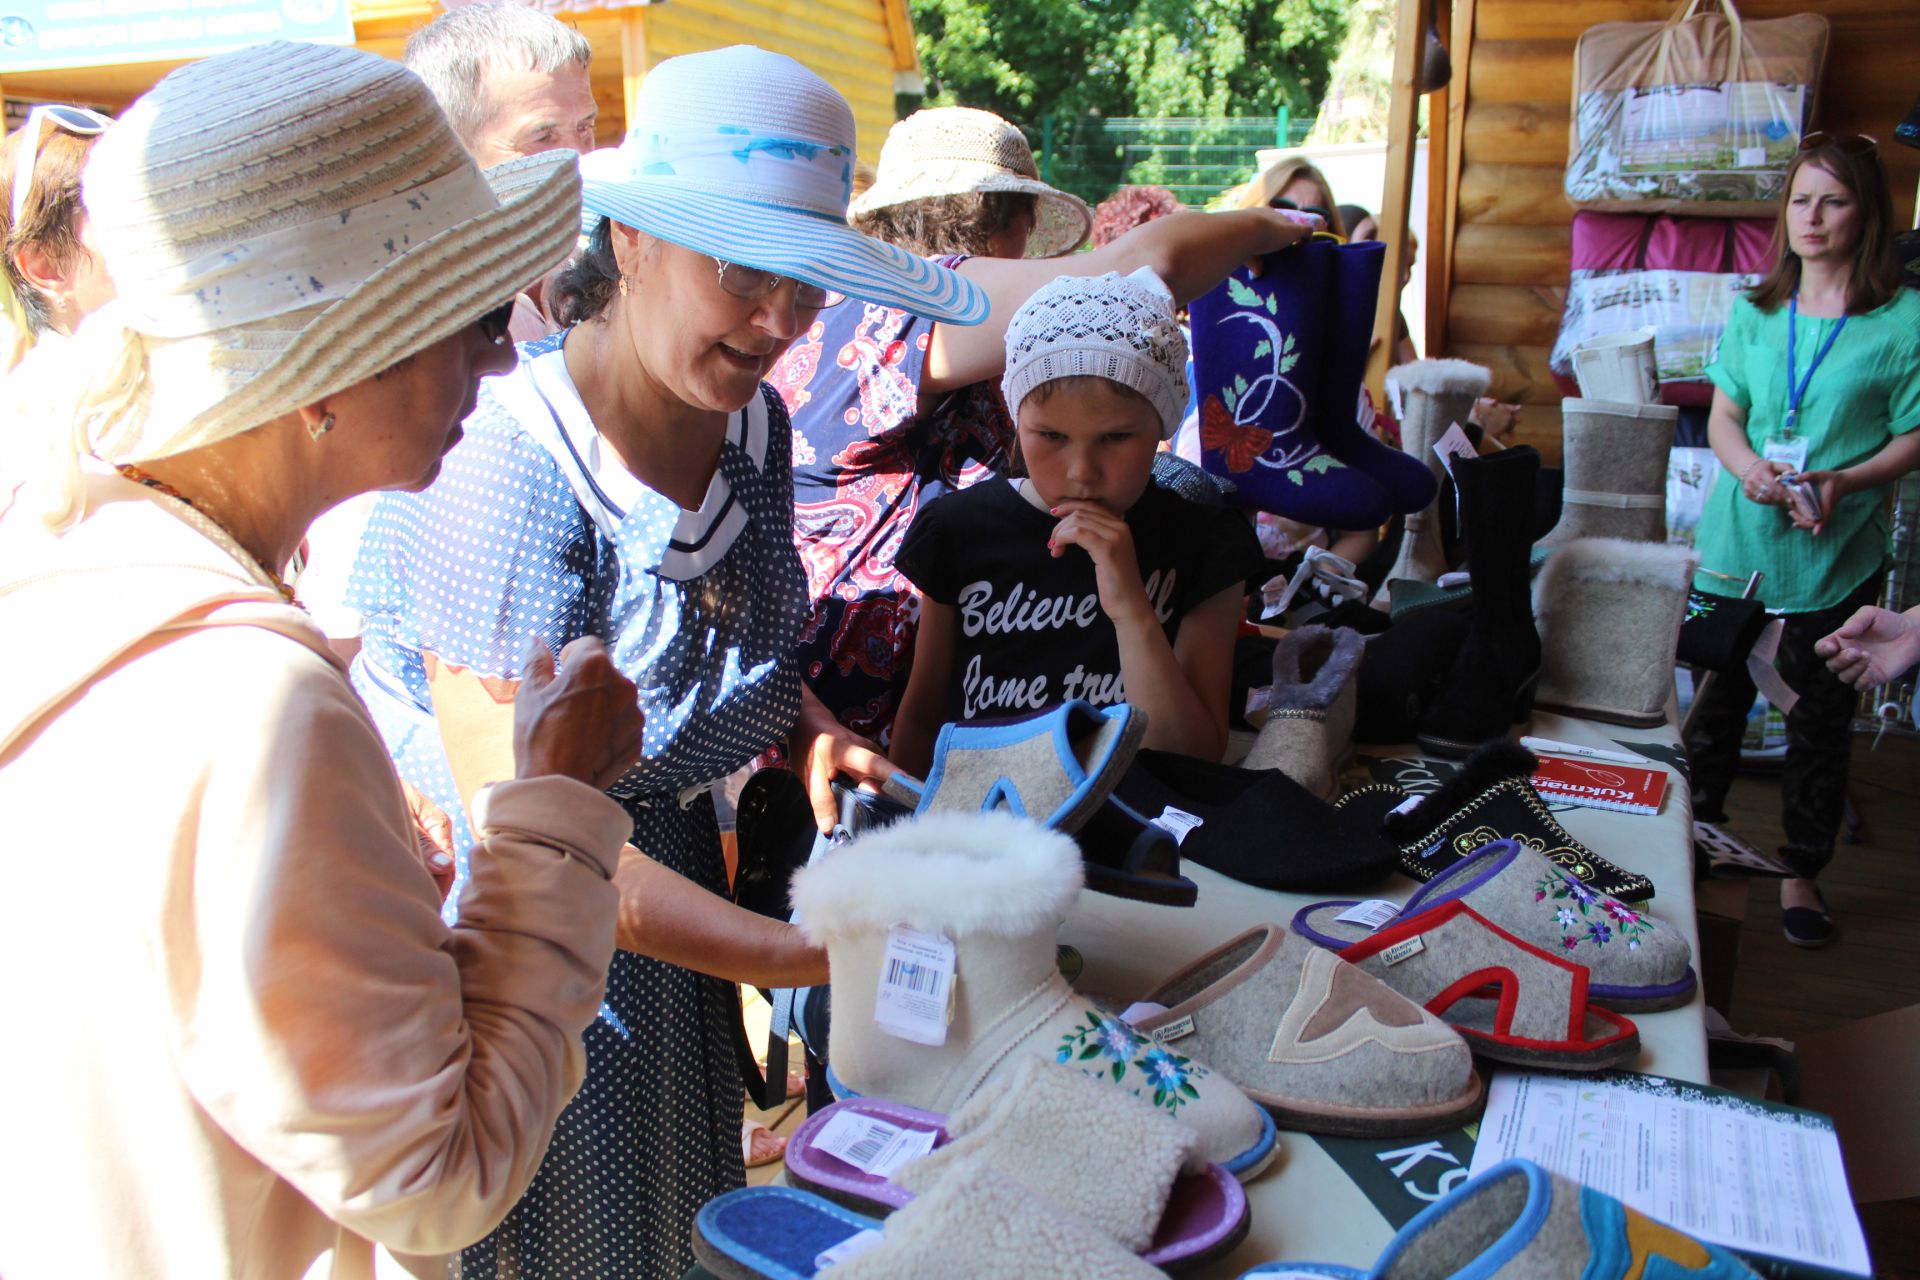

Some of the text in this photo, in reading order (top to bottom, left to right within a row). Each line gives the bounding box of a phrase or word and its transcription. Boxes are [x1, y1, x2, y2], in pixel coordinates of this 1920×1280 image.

[958, 568, 1177, 638] Believe ll
[1063, 664, 1128, 706] tru
